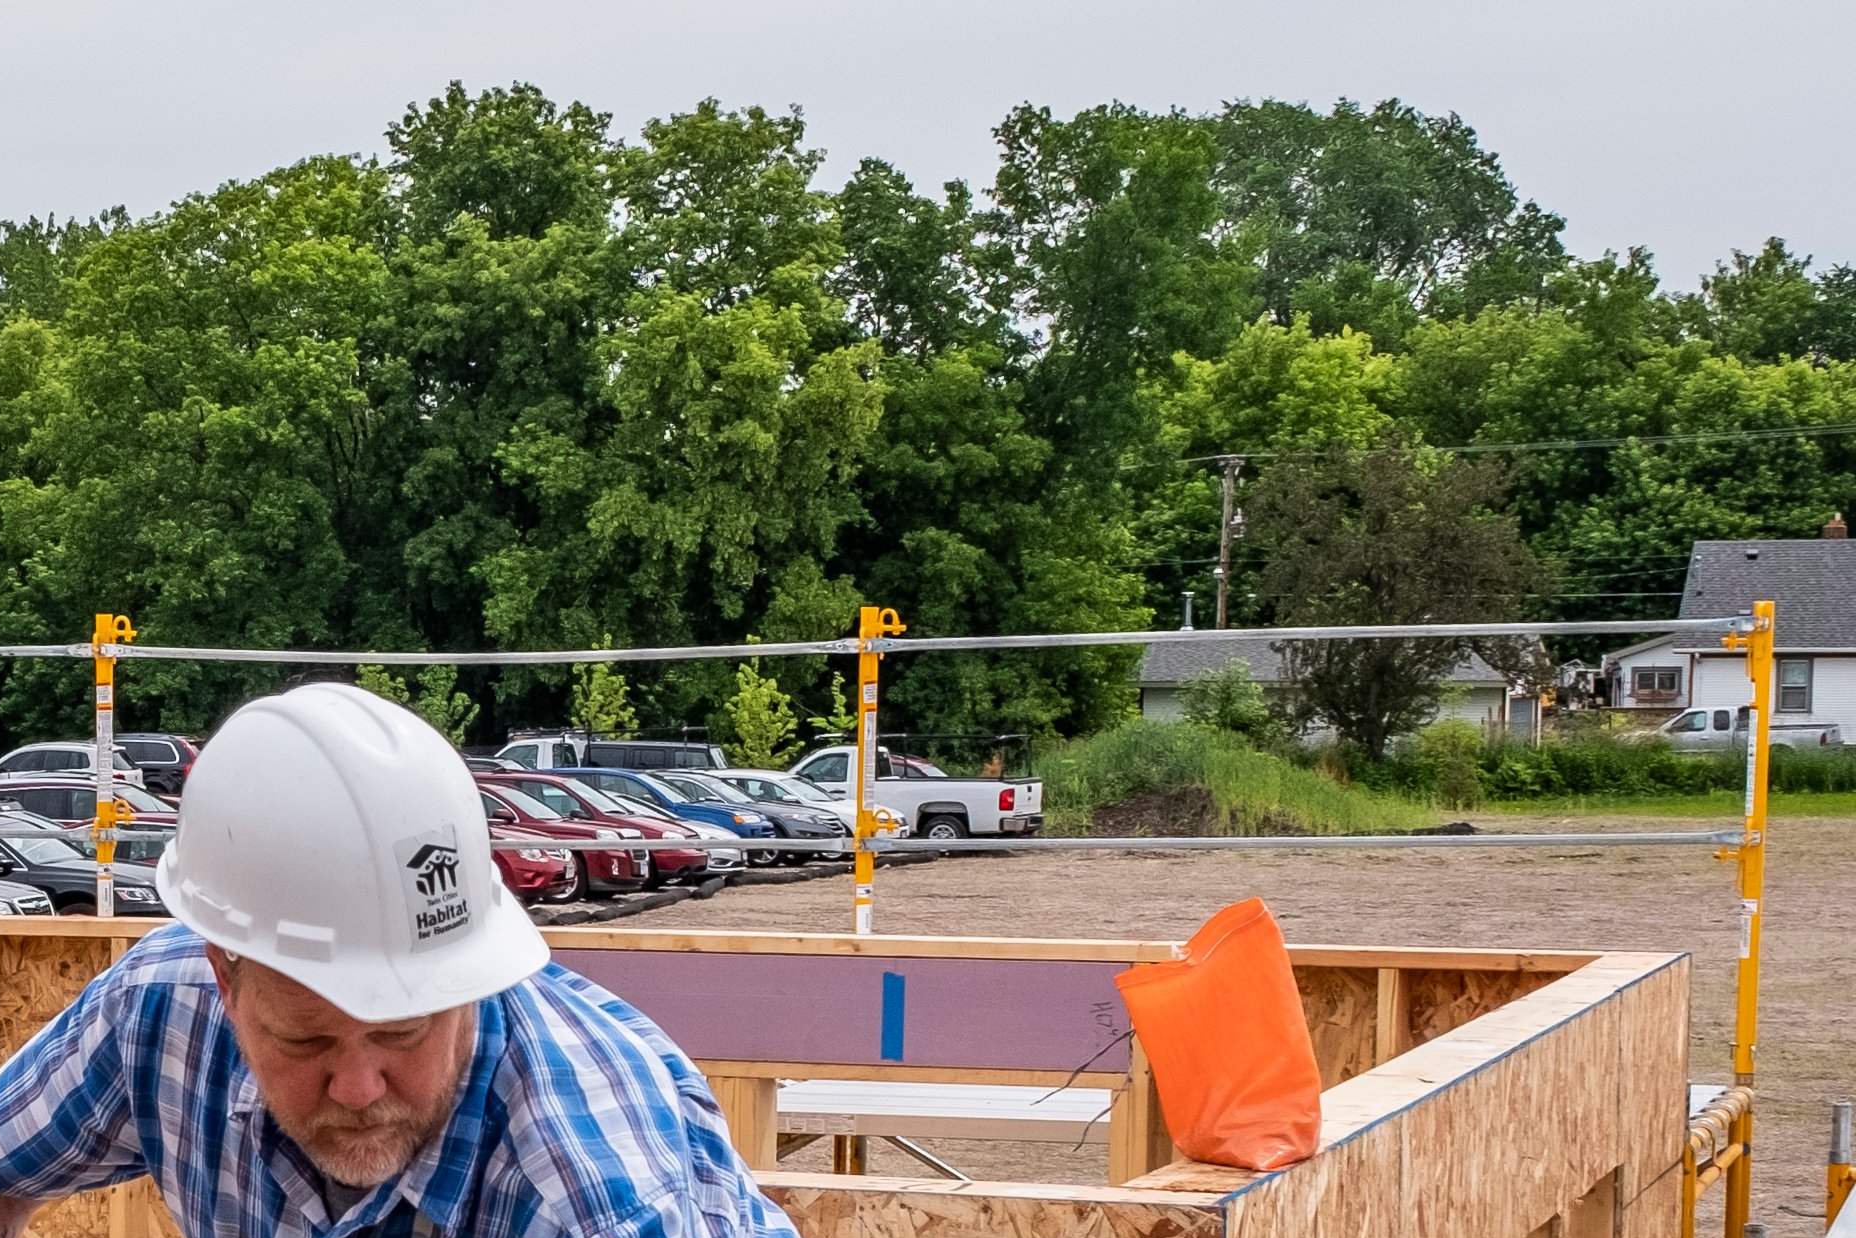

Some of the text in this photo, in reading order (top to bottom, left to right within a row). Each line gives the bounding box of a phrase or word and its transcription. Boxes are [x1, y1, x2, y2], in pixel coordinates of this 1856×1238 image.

[416, 899, 468, 929] Habitat
[418, 917, 469, 940] for Humanity
